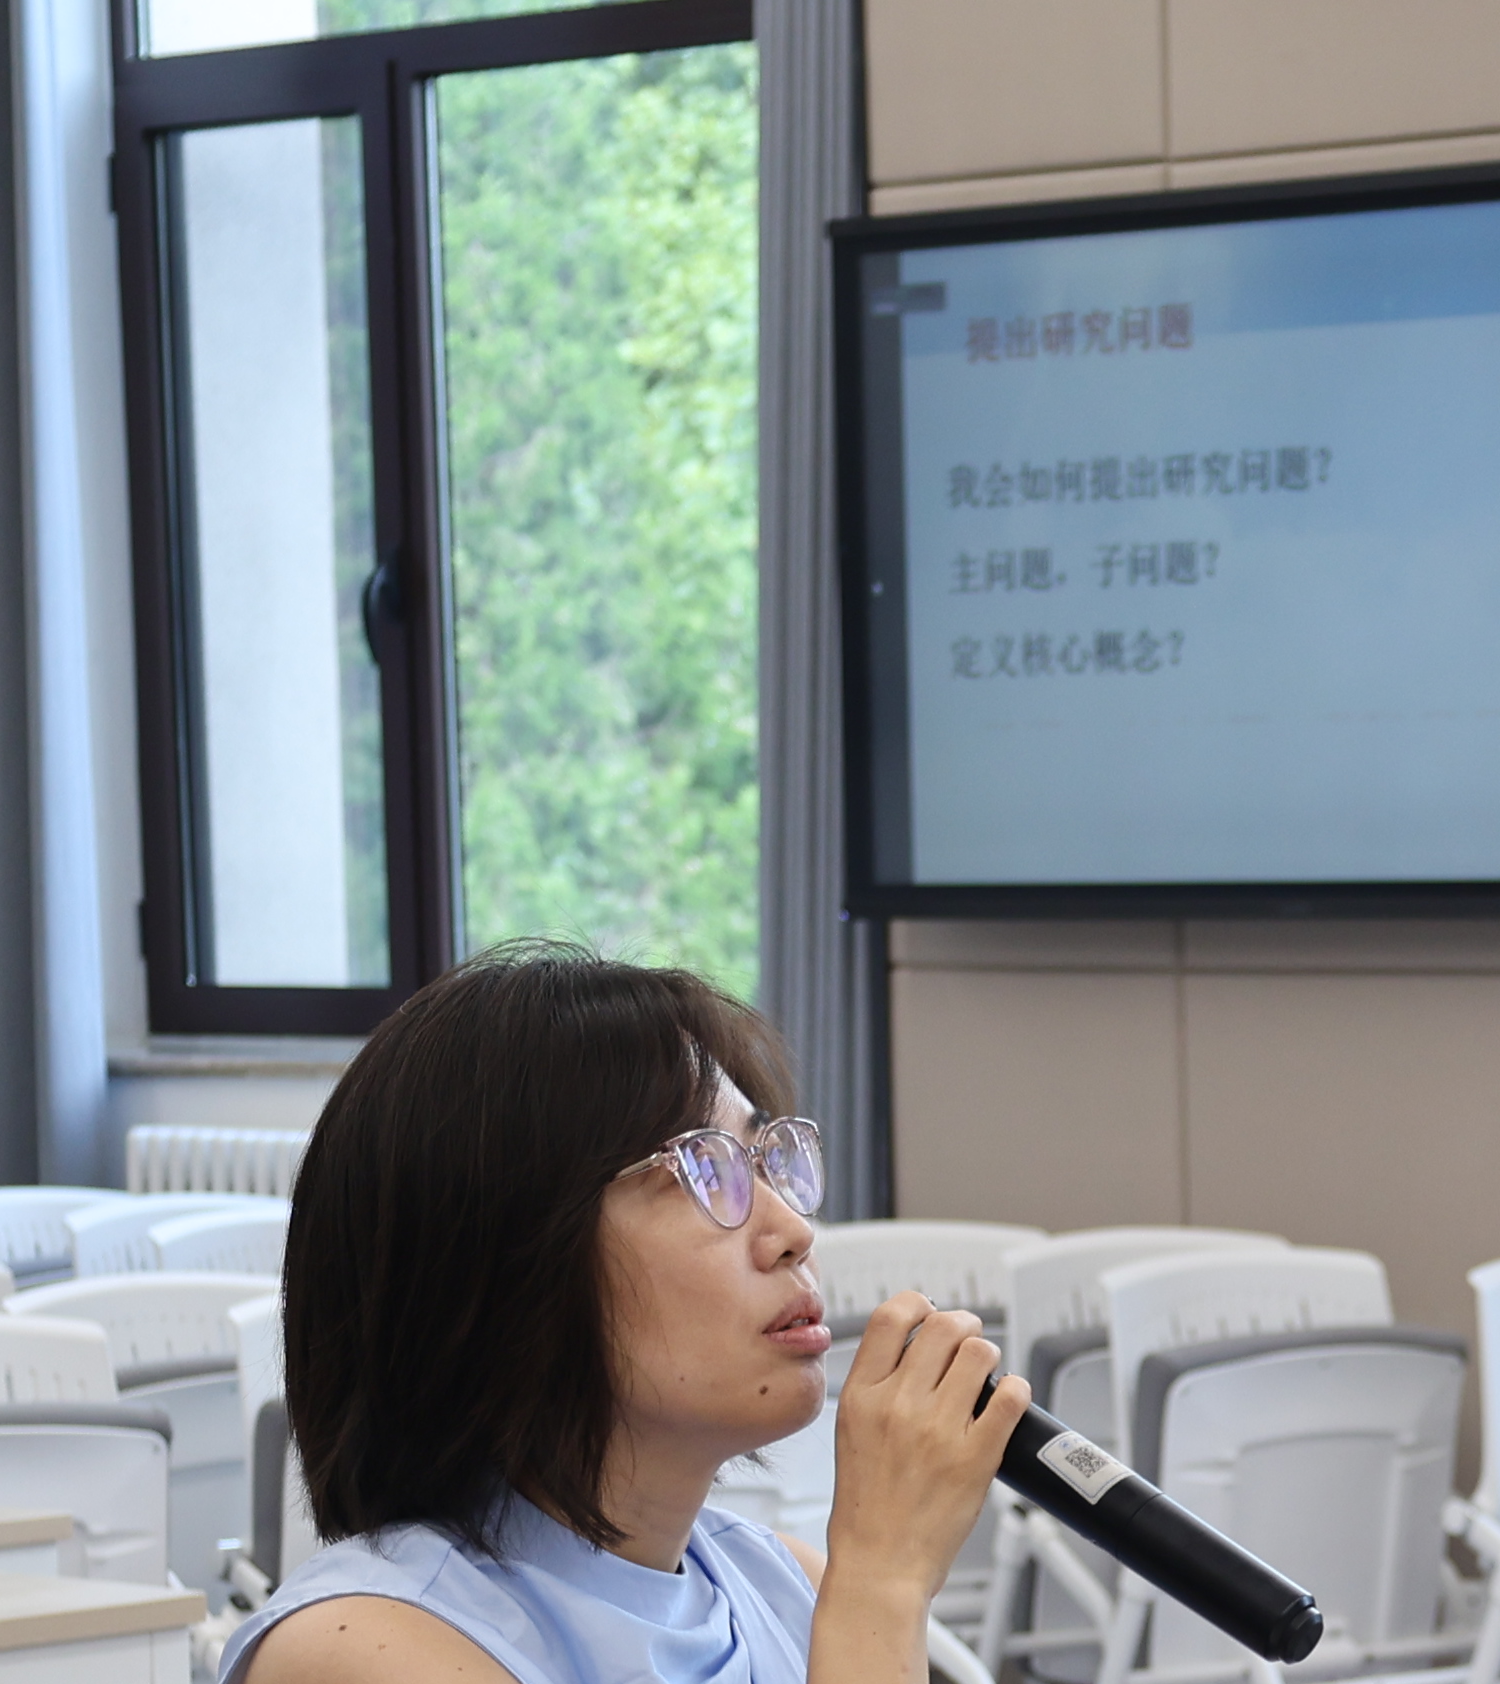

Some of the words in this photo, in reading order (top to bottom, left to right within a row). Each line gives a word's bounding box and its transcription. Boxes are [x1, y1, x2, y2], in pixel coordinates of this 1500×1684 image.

[967, 303, 1195, 363] 提出研究问题
[948, 446, 1333, 508] 我会如何提出研究问题？
